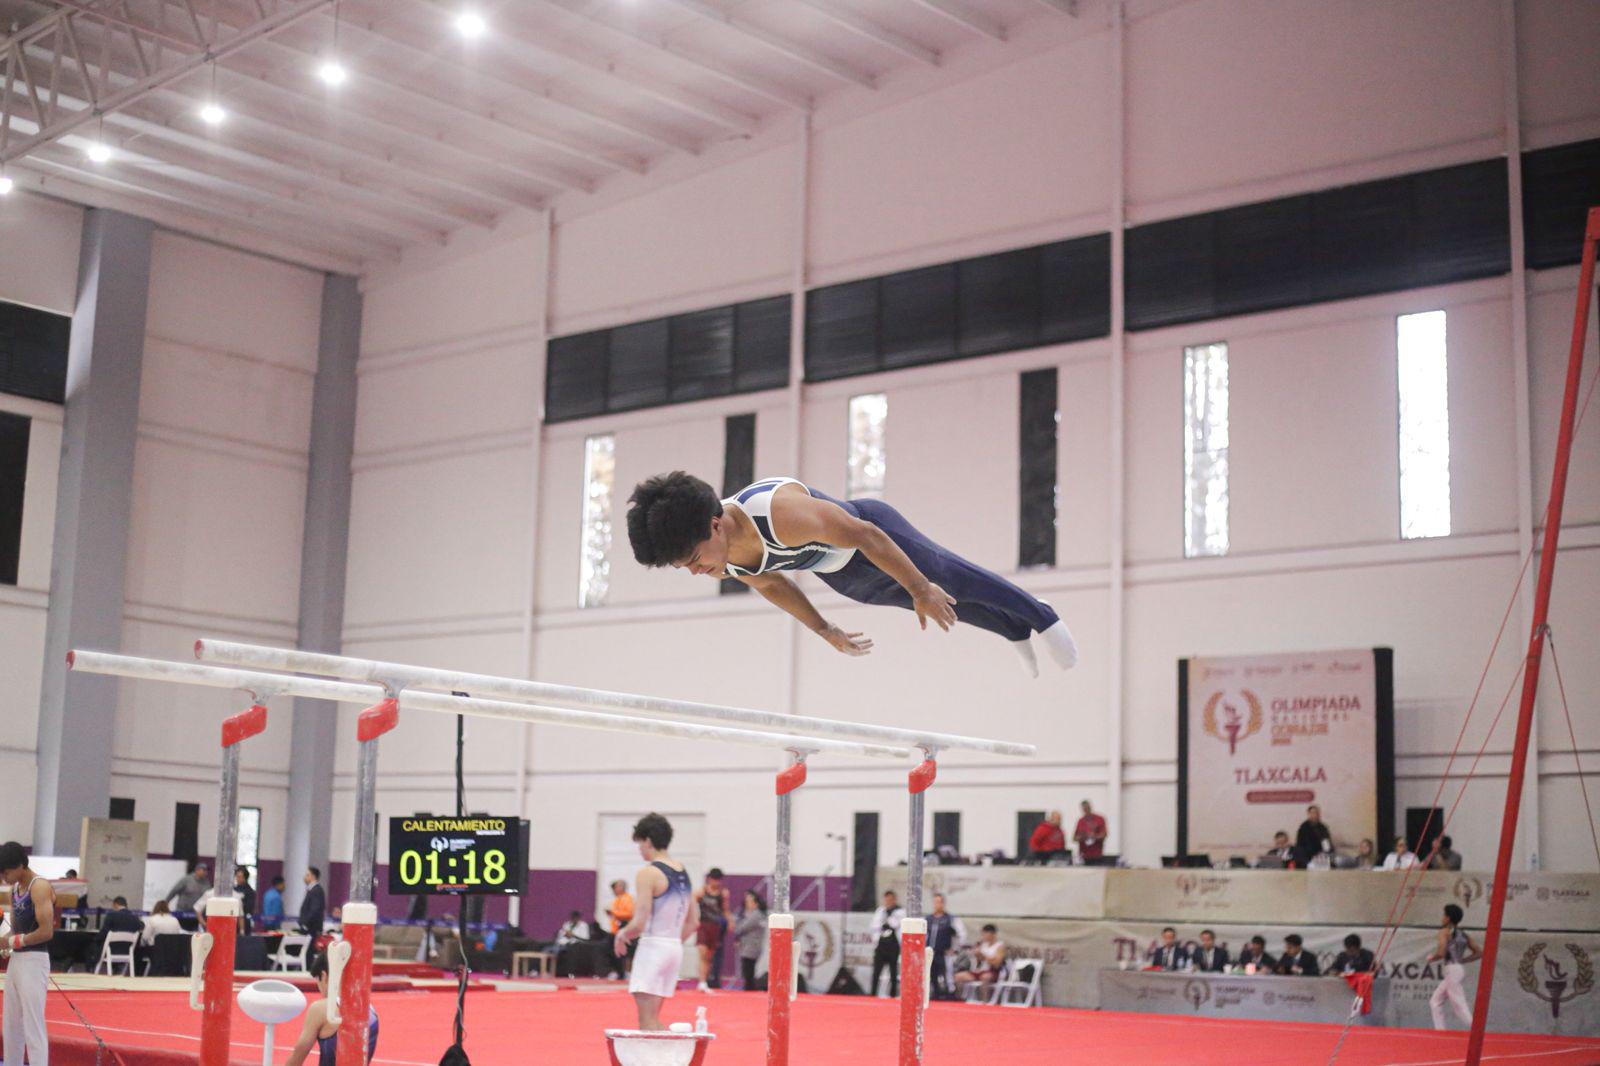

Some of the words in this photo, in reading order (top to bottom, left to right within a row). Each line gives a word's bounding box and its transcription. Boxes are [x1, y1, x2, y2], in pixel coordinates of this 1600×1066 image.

[1271, 696, 1361, 712] OLIMPIADA
[1234, 767, 1328, 784] TLAXCALA
[402, 819, 506, 832] CALENTAMIENTO
[400, 849, 506, 886] 01:18
